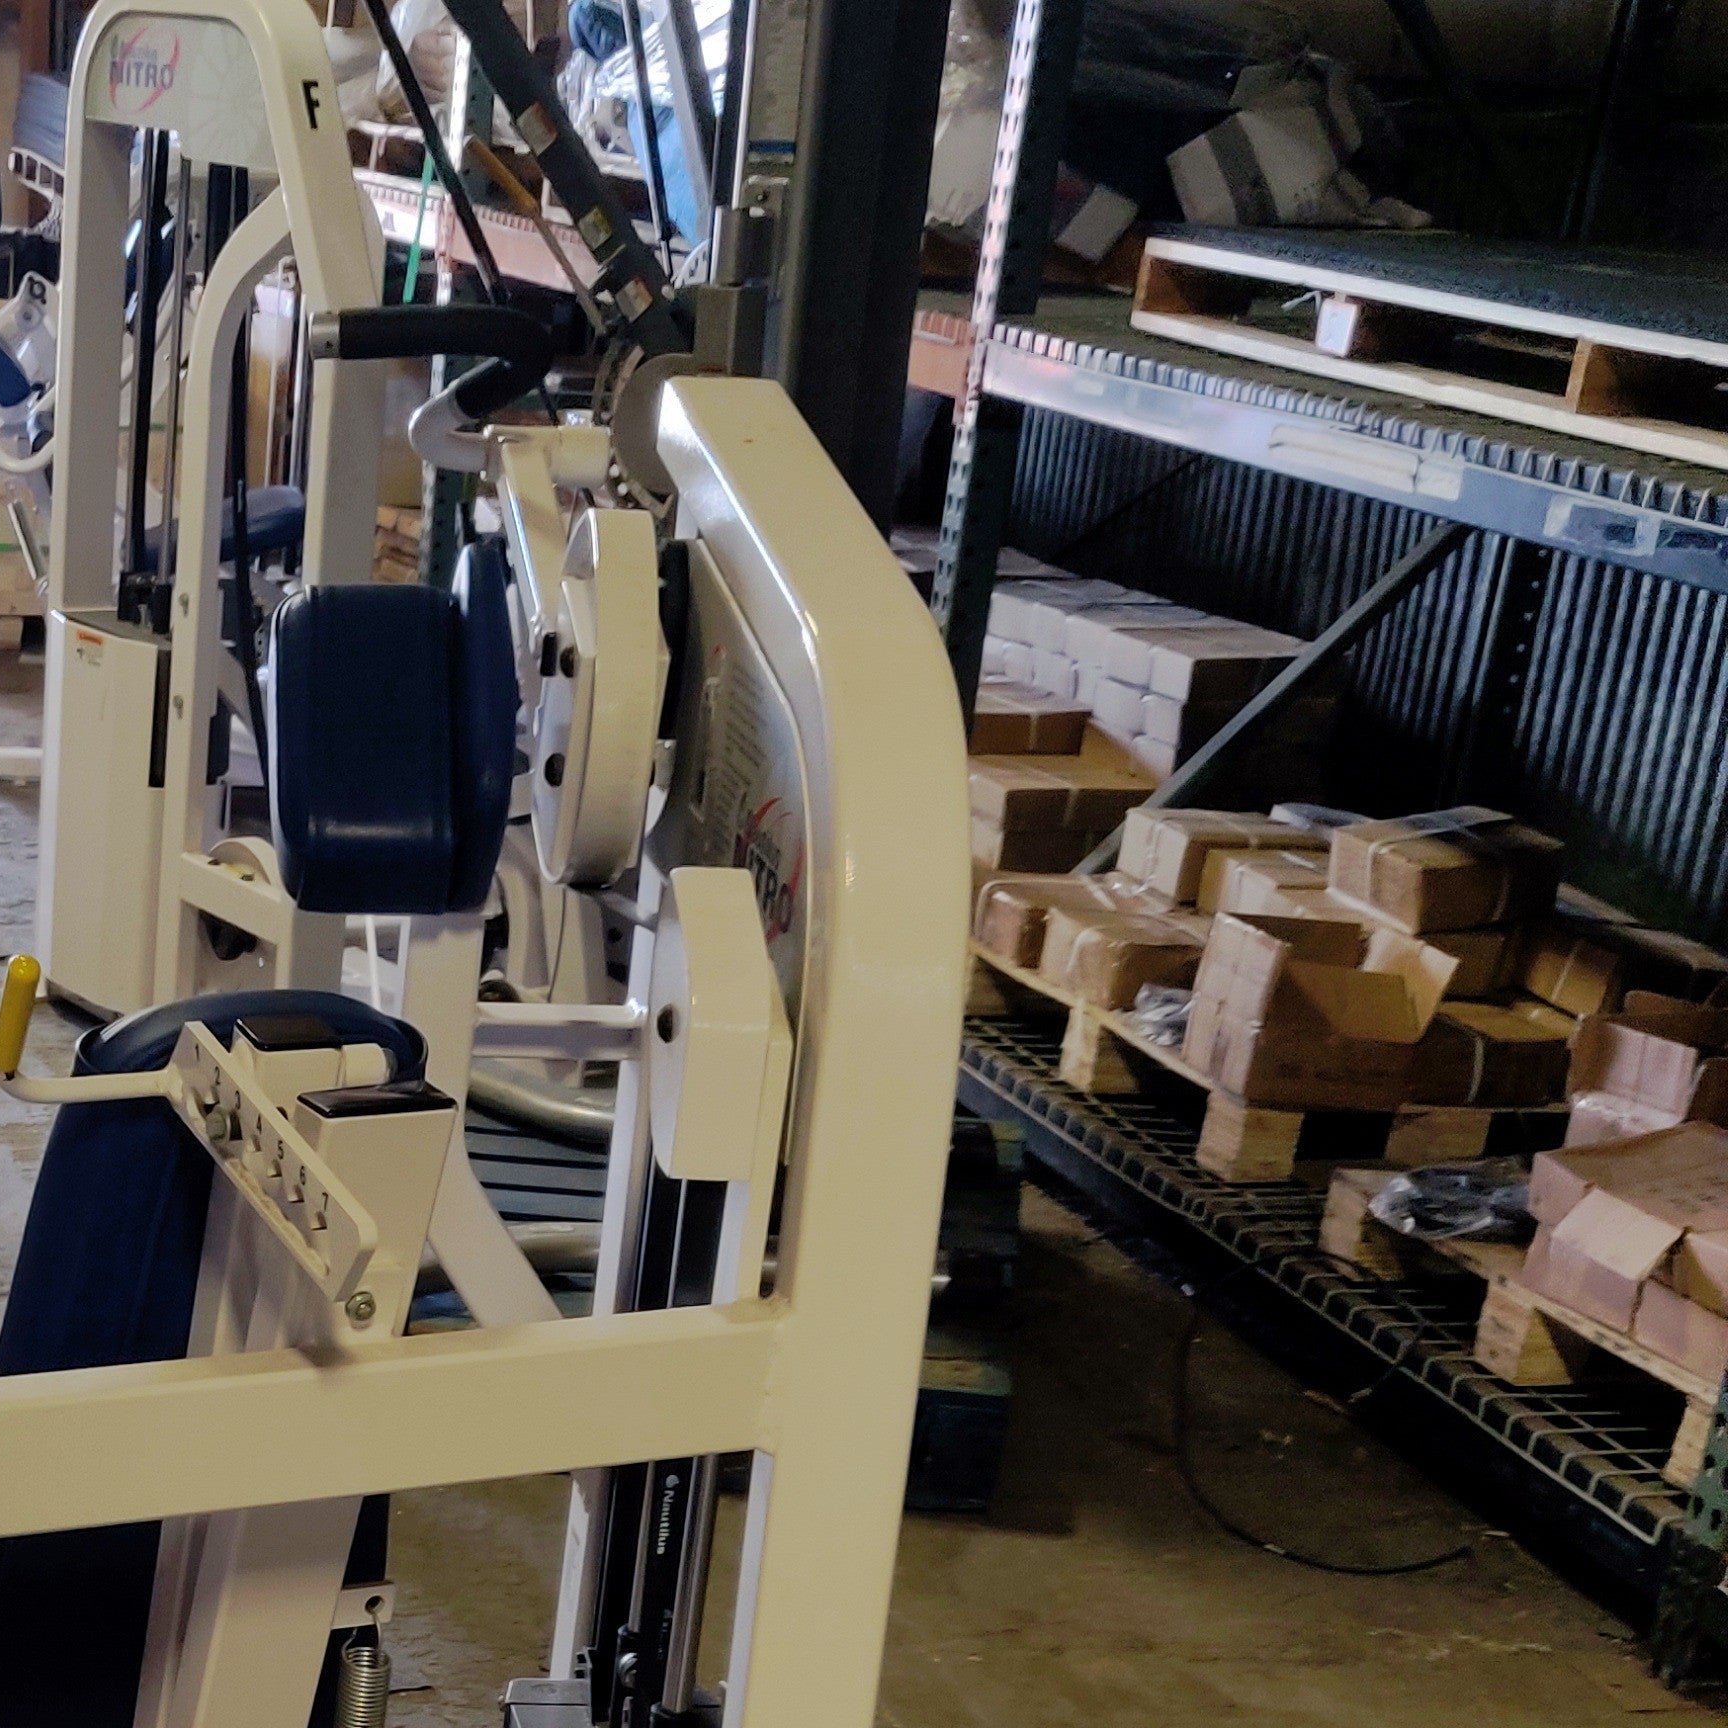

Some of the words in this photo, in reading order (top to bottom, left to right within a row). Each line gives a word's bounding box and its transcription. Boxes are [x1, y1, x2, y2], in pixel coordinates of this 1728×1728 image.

[109, 61, 174, 90] NITRO
[303, 79, 320, 130] F
[213, 1065, 221, 1085] 2
[234, 1090, 241, 1110] 3
[255, 1113, 263, 1135] 4
[277, 1139, 285, 1160] 5
[299, 1165, 307, 1186] 6
[322, 1192, 329, 1213] 7
[656, 1489, 675, 1556] Nautilus
